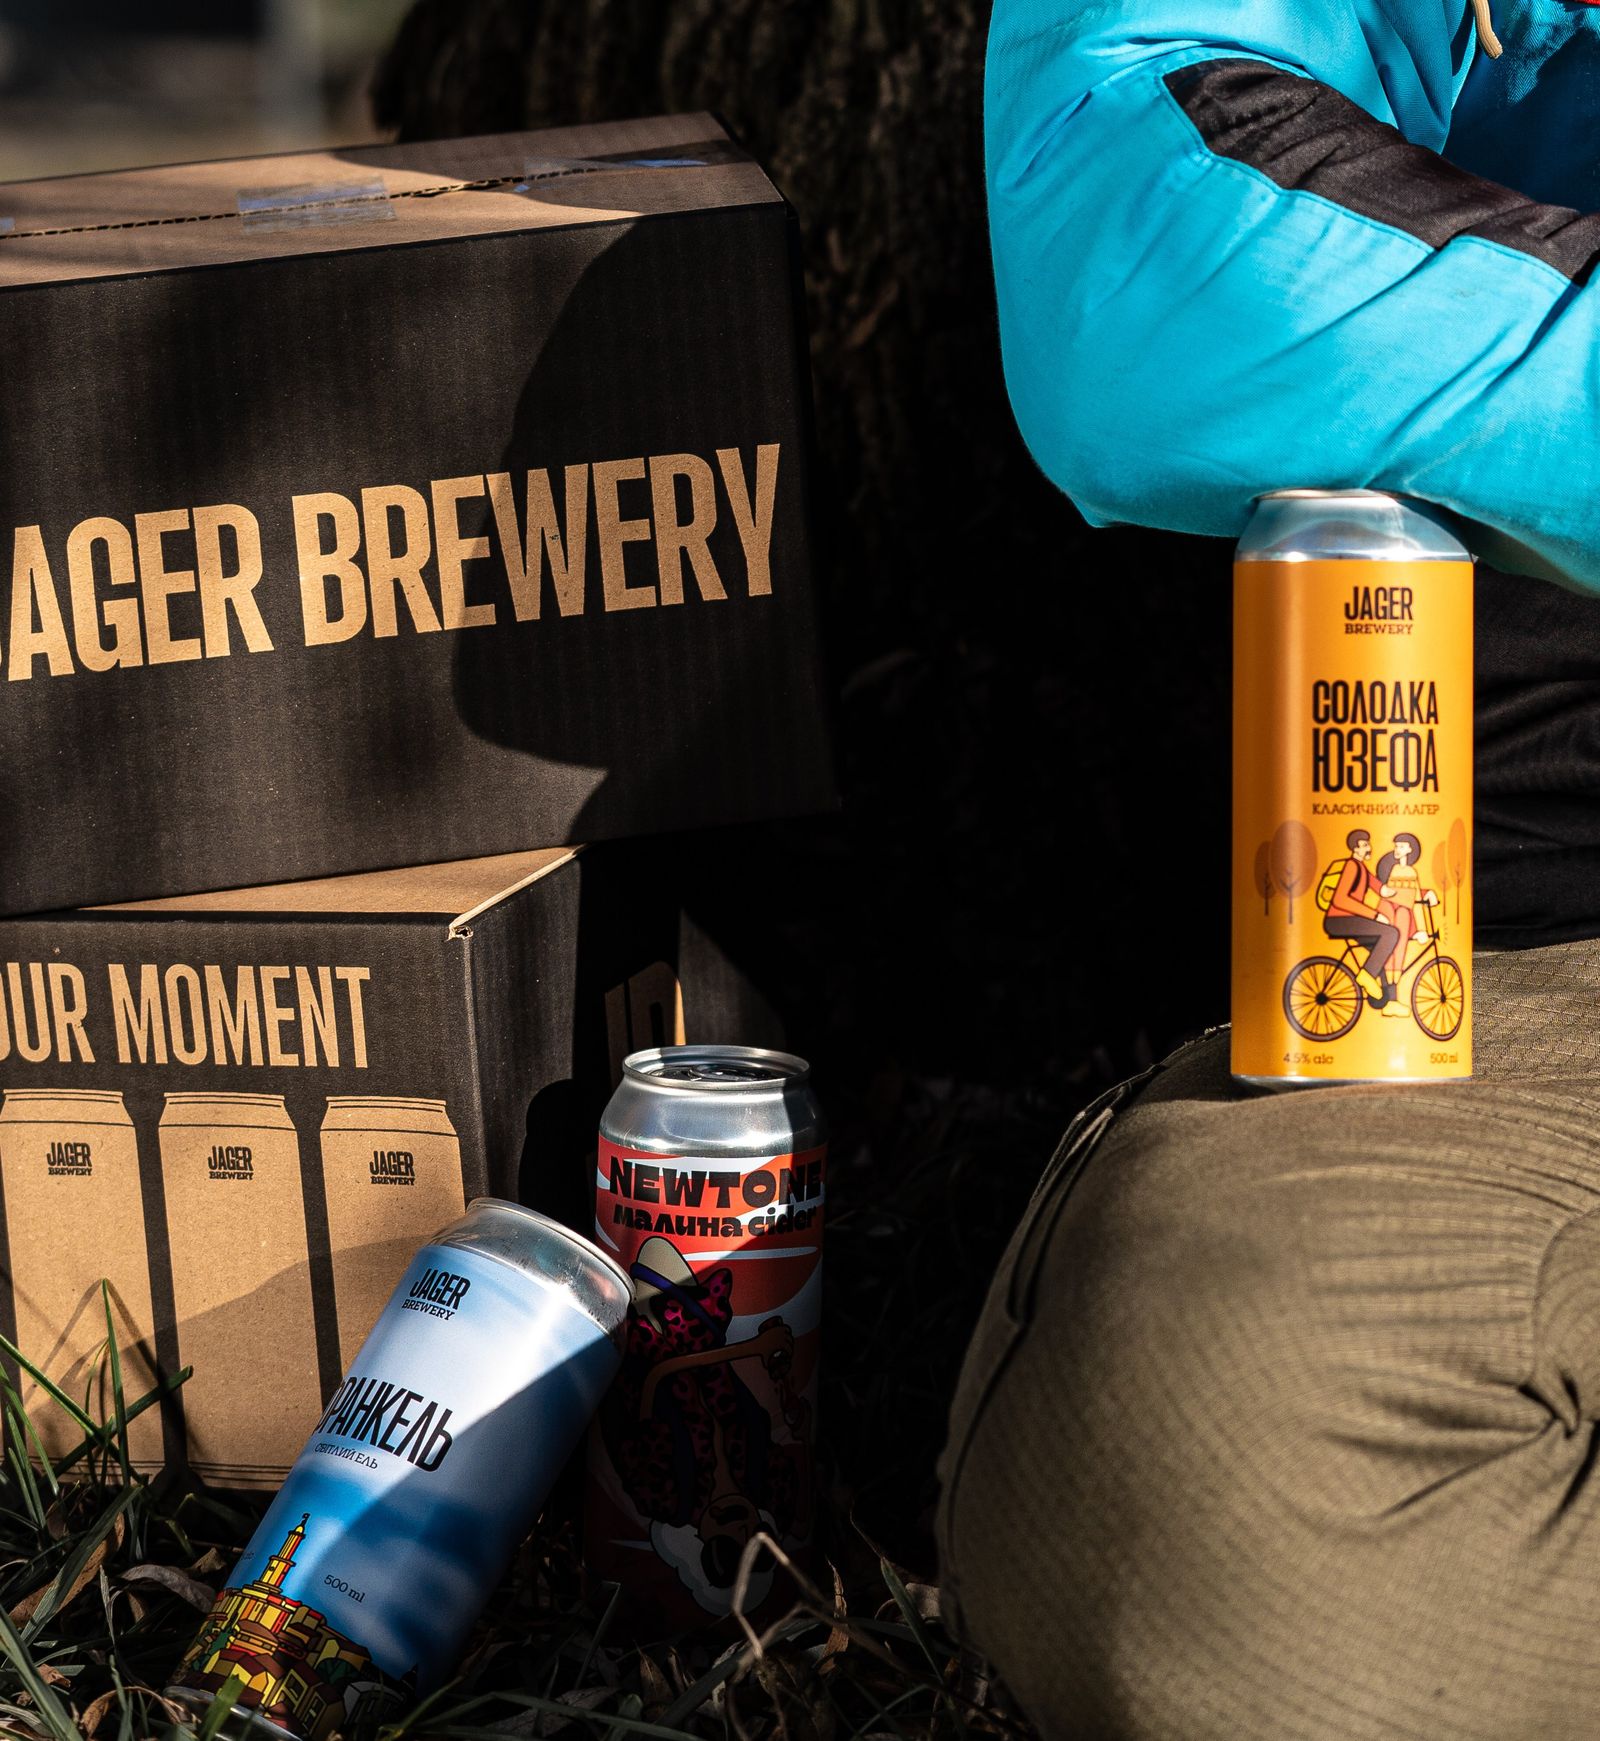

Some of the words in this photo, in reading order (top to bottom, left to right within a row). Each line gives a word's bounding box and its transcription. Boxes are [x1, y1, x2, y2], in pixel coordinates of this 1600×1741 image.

[0, 504, 274, 682] AGER
[292, 444, 780, 646] BREWERY
[1344, 586, 1414, 620] JAGER
[1344, 622, 1414, 635] BREWERY
[1312, 679, 1439, 725] СОЛОДКА
[1312, 727, 1439, 792] ЮЗЕФА
[1312, 802, 1399, 816] КЛАСИЧНИЙ
[1403, 803, 1440, 816] ЛАГЕР
[0, 962, 96, 1063] UR
[108, 963, 371, 1068] MOMENT
[1283, 1052, 1311, 1065] 45%
[1313, 1053, 1334, 1065] alc
[1430, 1052, 1449, 1064] 500
[1449, 1052, 1458, 1064] ml
[46, 1142, 92, 1167] JAGER
[208, 1145, 254, 1171] JAGER
[369, 1151, 415, 1176] JAGER
[48, 1167, 93, 1176] BREWERY
[209, 1171, 254, 1180] BREWERY
[370, 1176, 415, 1186] BREWERY
[609, 1155, 823, 1209] NEWTONE
[748, 1205, 817, 1237] cider
[409, 1268, 471, 1310] JAGER
[402, 1299, 456, 1320] BREWERY
[314, 1442, 356, 1460] СВІТЛИЙ
[355, 1452, 378, 1470] ЕЛЬ
[324, 1574, 349, 1593] 500
[348, 1588, 366, 1603] ml
